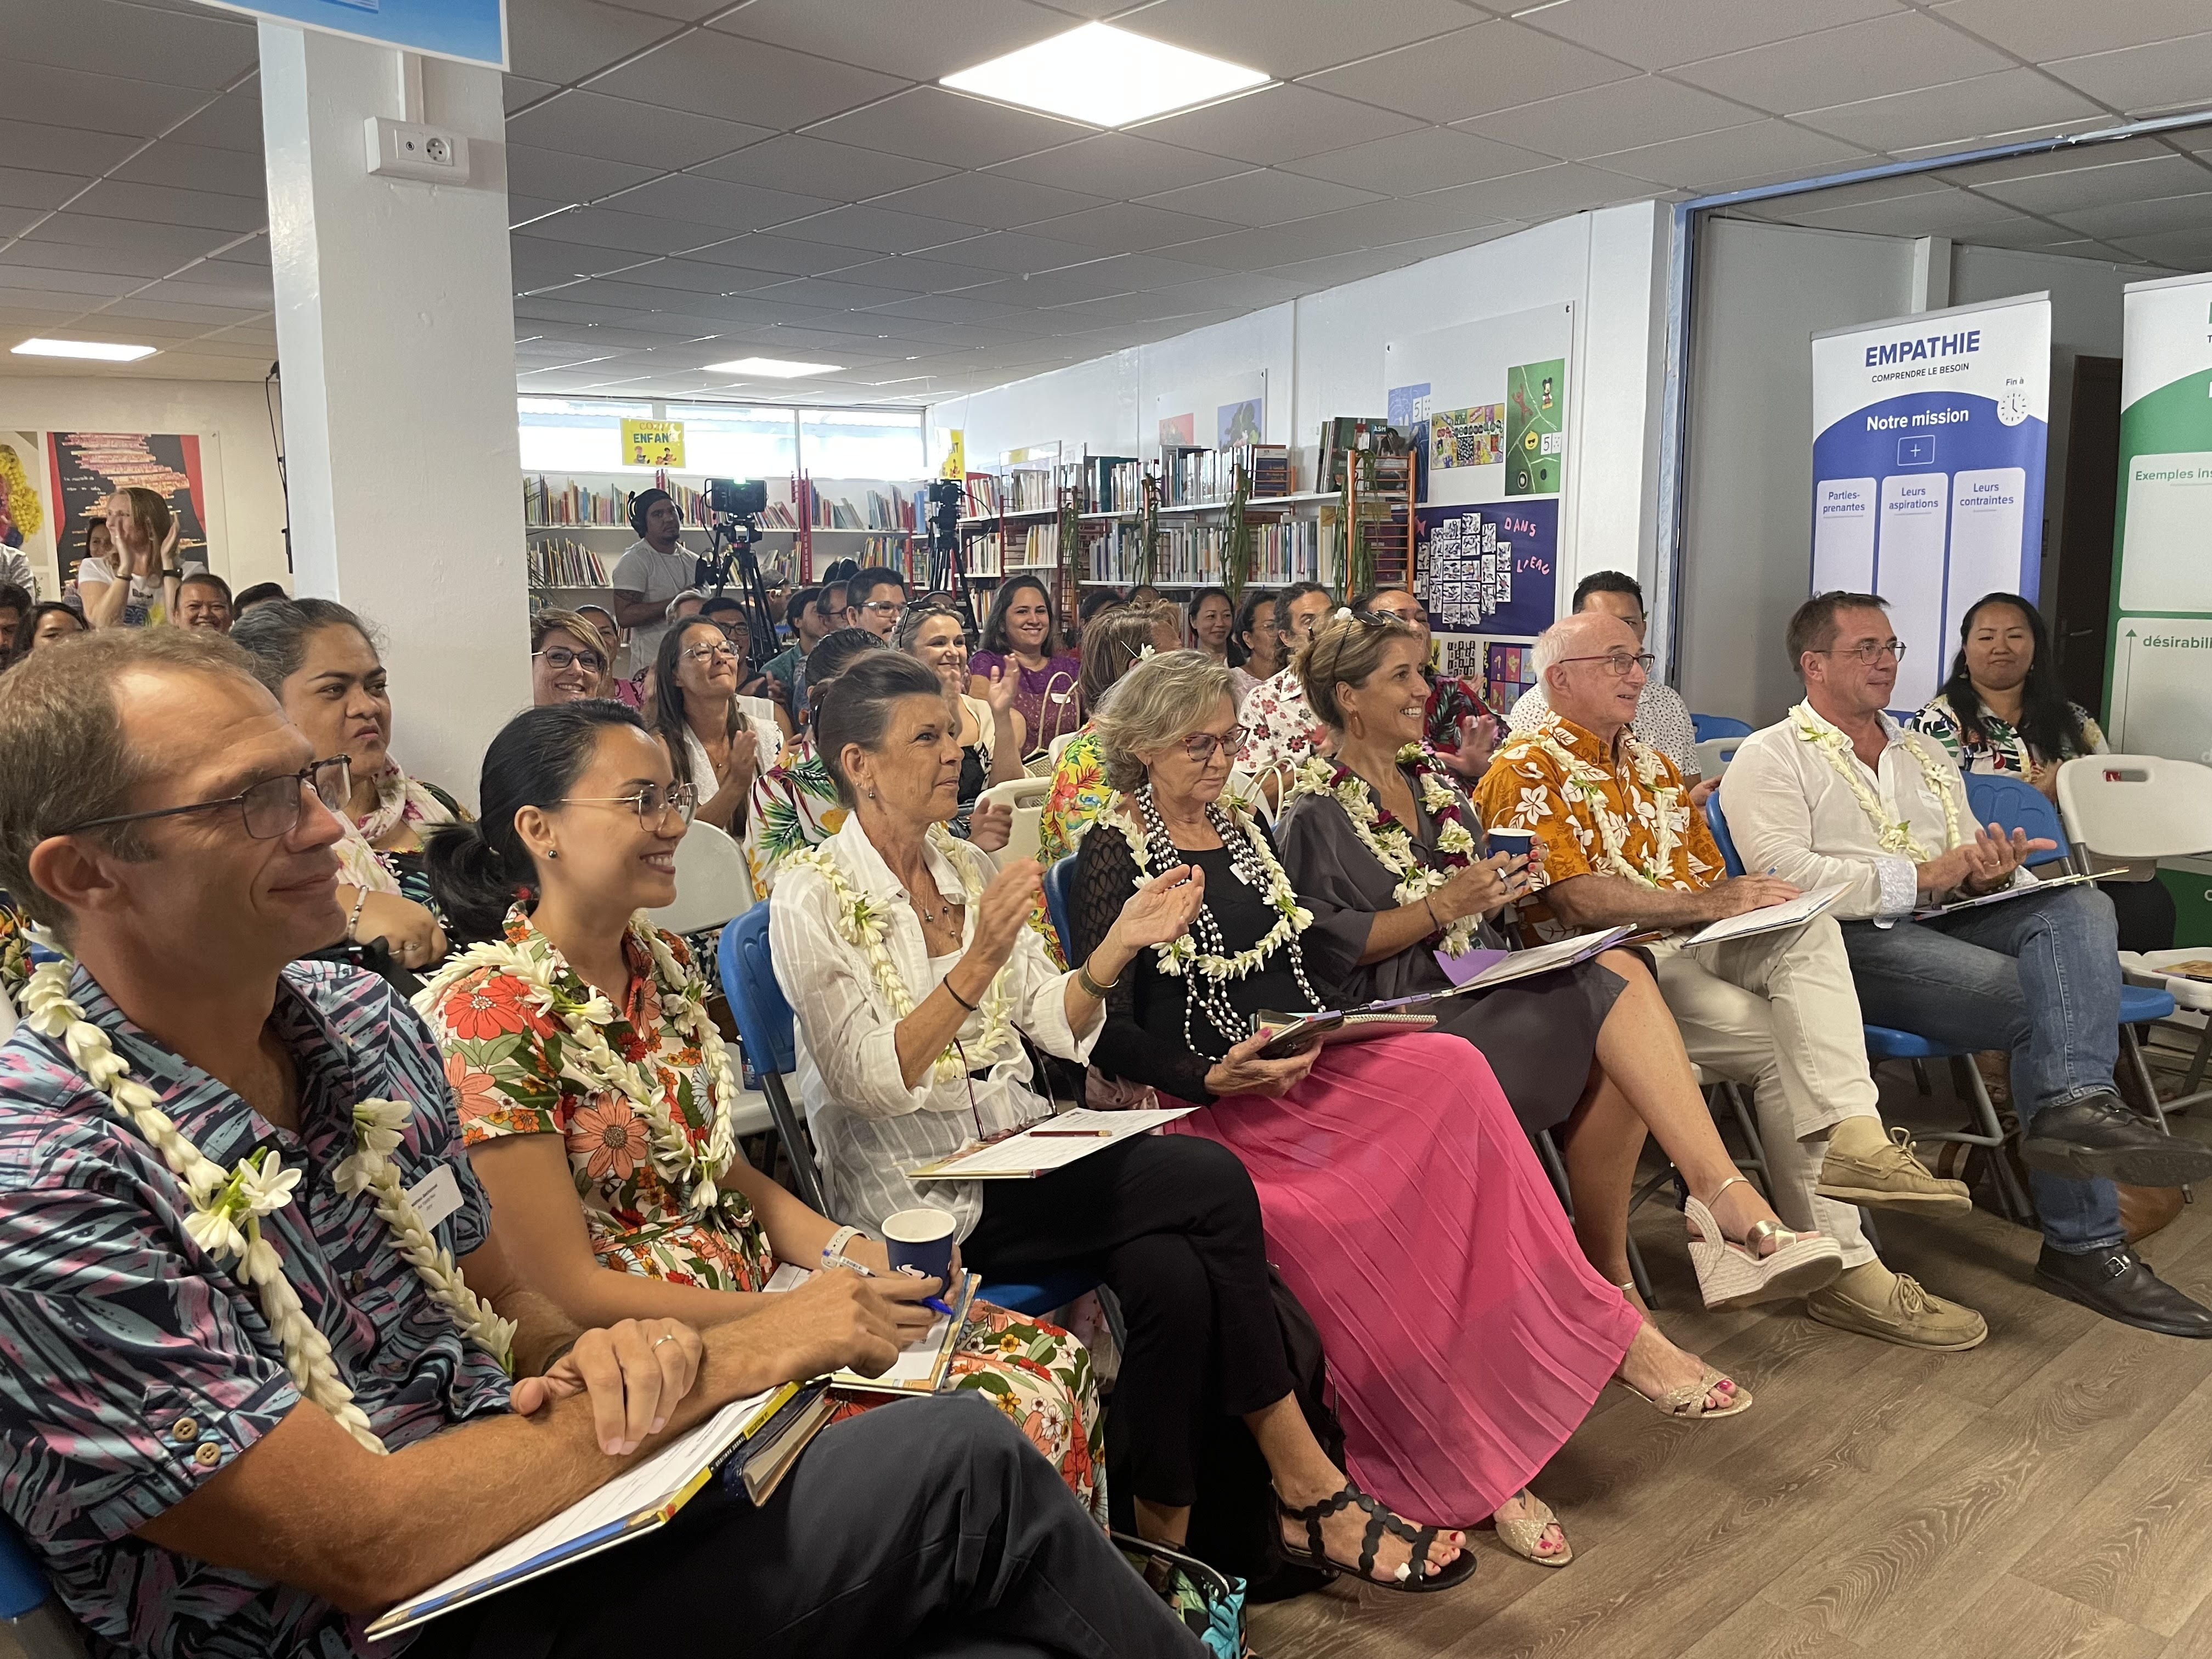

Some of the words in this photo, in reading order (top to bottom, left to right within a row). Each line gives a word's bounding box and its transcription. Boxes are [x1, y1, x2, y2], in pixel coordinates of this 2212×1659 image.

[1865, 330, 1980, 367] EMPATHIE
[1872, 369, 1926, 383] COMPRENDRE
[1928, 367, 1937, 375] LE
[1940, 363, 1970, 374] BESOIN
[1867, 416, 1908, 431] Notre
[1912, 408, 1968, 426] mission
[634, 433, 670, 443] ENFAN
[1543, 437, 1550, 451] 5
[2136, 469, 2193, 481] Exemples
[1901, 487, 1926, 496] Leurs
[1974, 483, 1999, 493] Leurs
[1829, 490, 1860, 500] Parties-
[1960, 495, 2014, 506] contraintes
[1823, 503, 1865, 514] prenantes
[1889, 499, 1938, 511] aspirations
[1504, 517, 1537, 537] DANS
[1516, 556, 1550, 575] L'EAU
